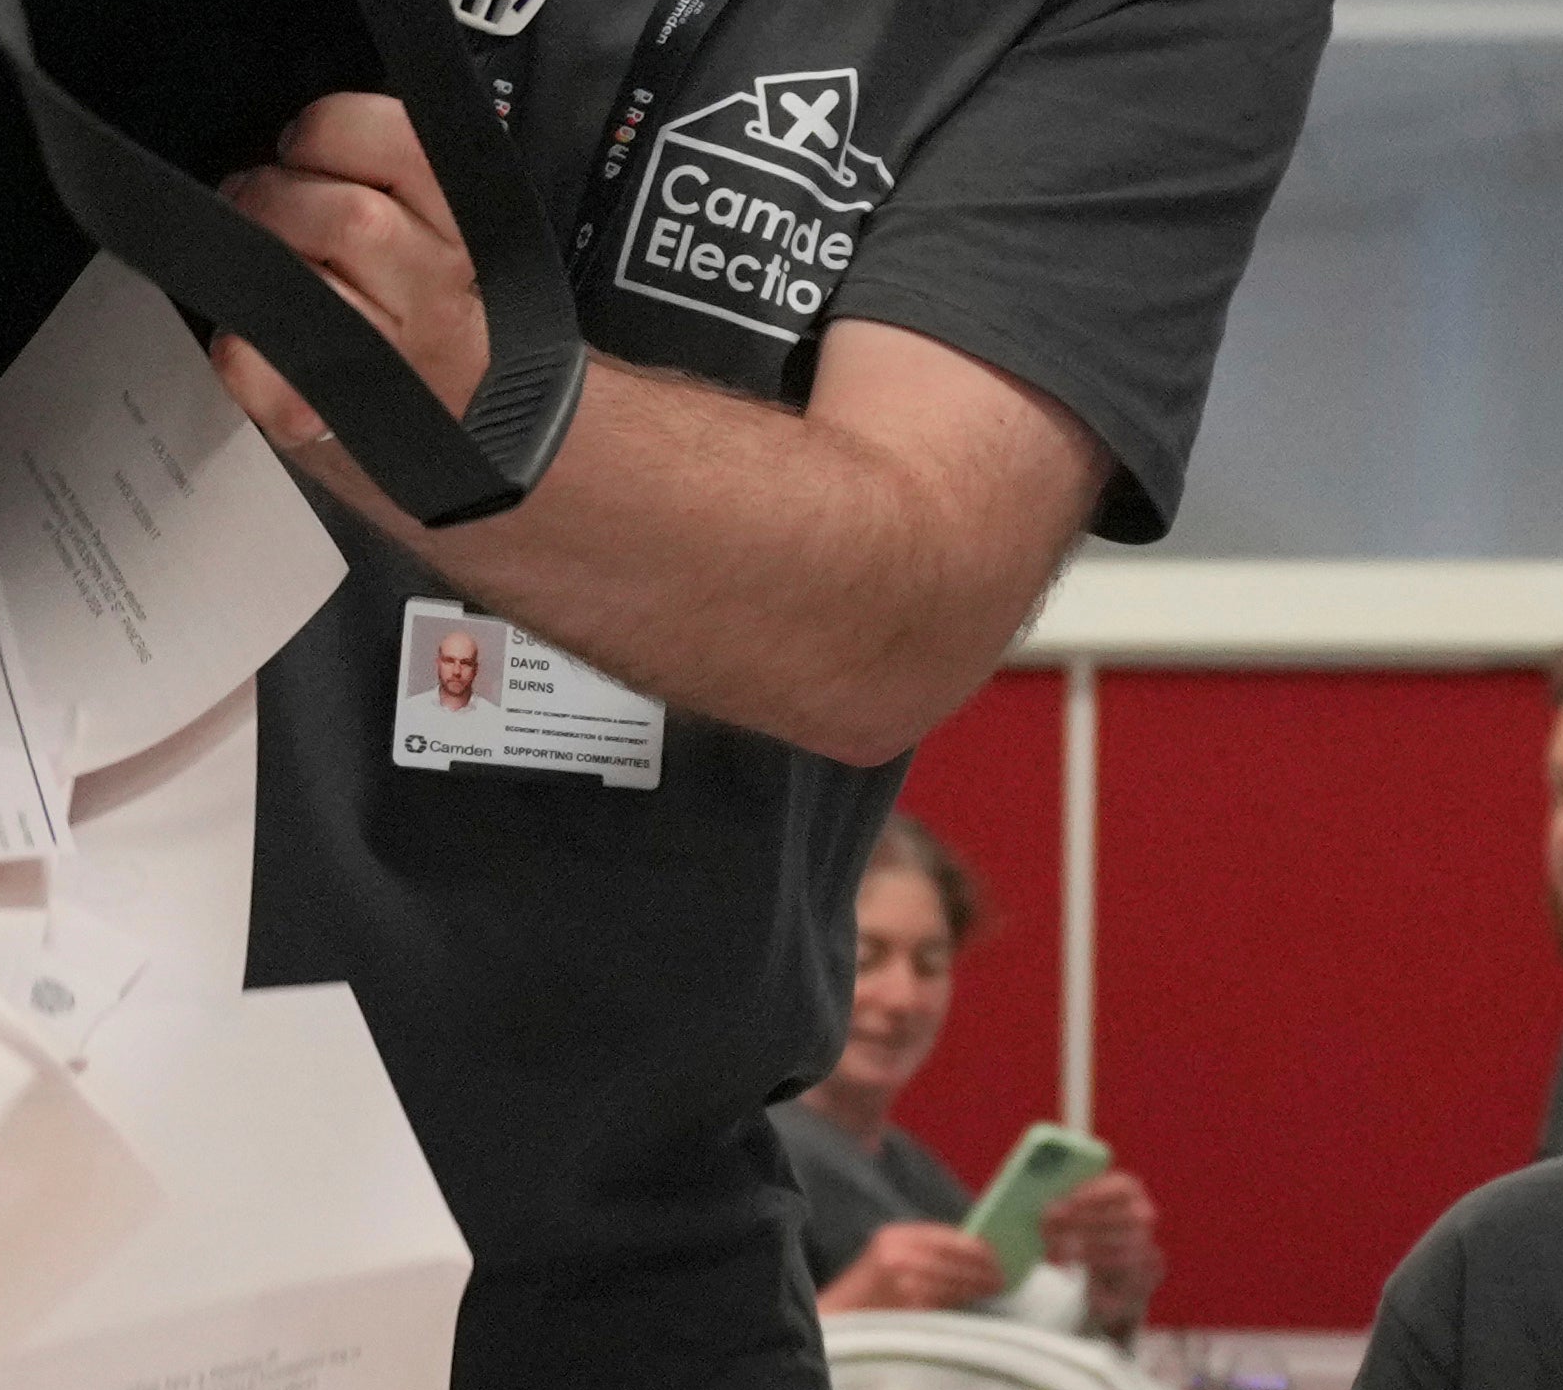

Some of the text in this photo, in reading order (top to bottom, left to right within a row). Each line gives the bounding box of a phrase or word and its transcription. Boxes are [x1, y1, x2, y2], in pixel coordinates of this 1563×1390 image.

[661, 165, 853, 270] Camde
[644, 220, 828, 315] Electio
[511, 657, 550, 671] DAVID
[509, 679, 554, 693] BURNS
[430, 740, 492, 757] Camden
[503, 746, 651, 769] SUPPORTING COMMUNITIES
